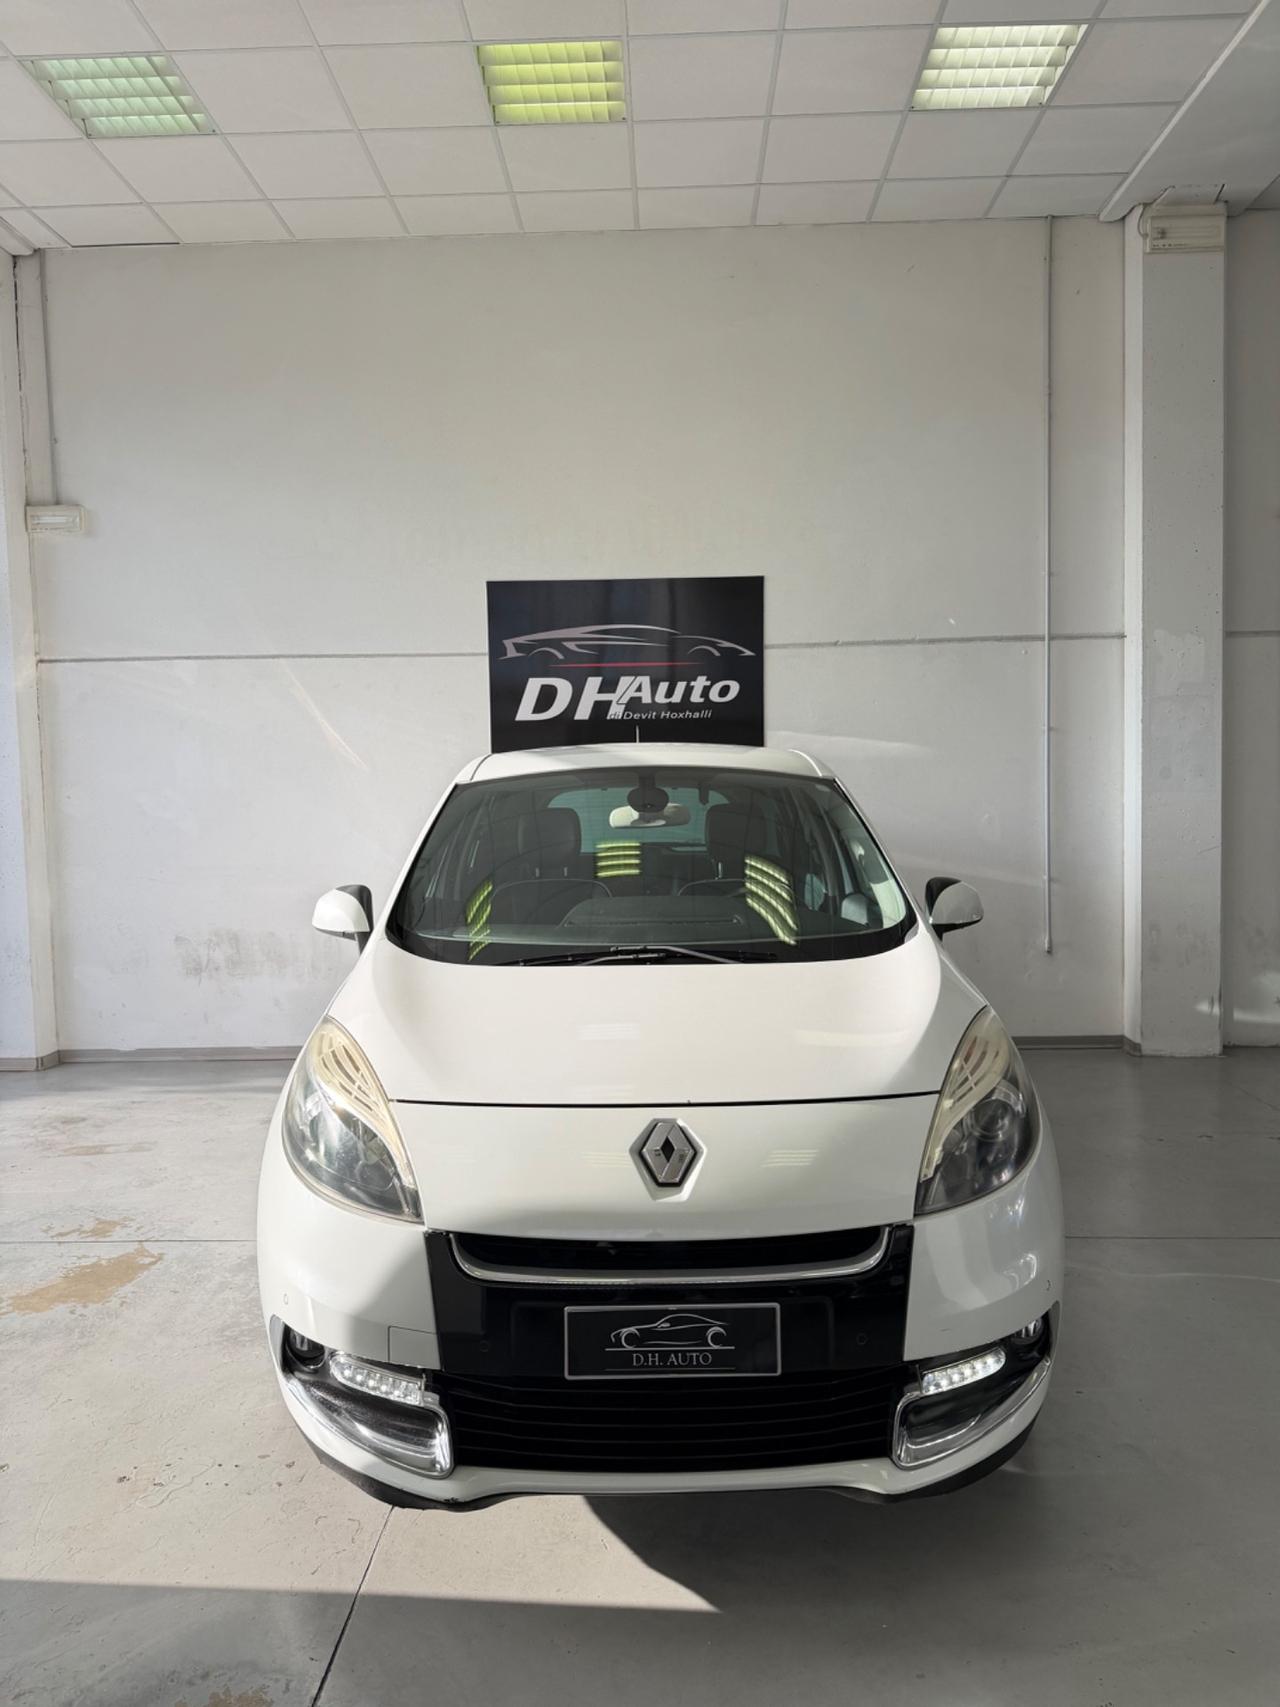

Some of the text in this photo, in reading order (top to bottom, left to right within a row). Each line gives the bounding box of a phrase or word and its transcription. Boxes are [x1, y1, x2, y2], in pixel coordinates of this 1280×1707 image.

[623, 710, 657, 720] Devit
[660, 709, 713, 719] Hoxhalli
[632, 1352, 712, 1366] D.H. AUTO
